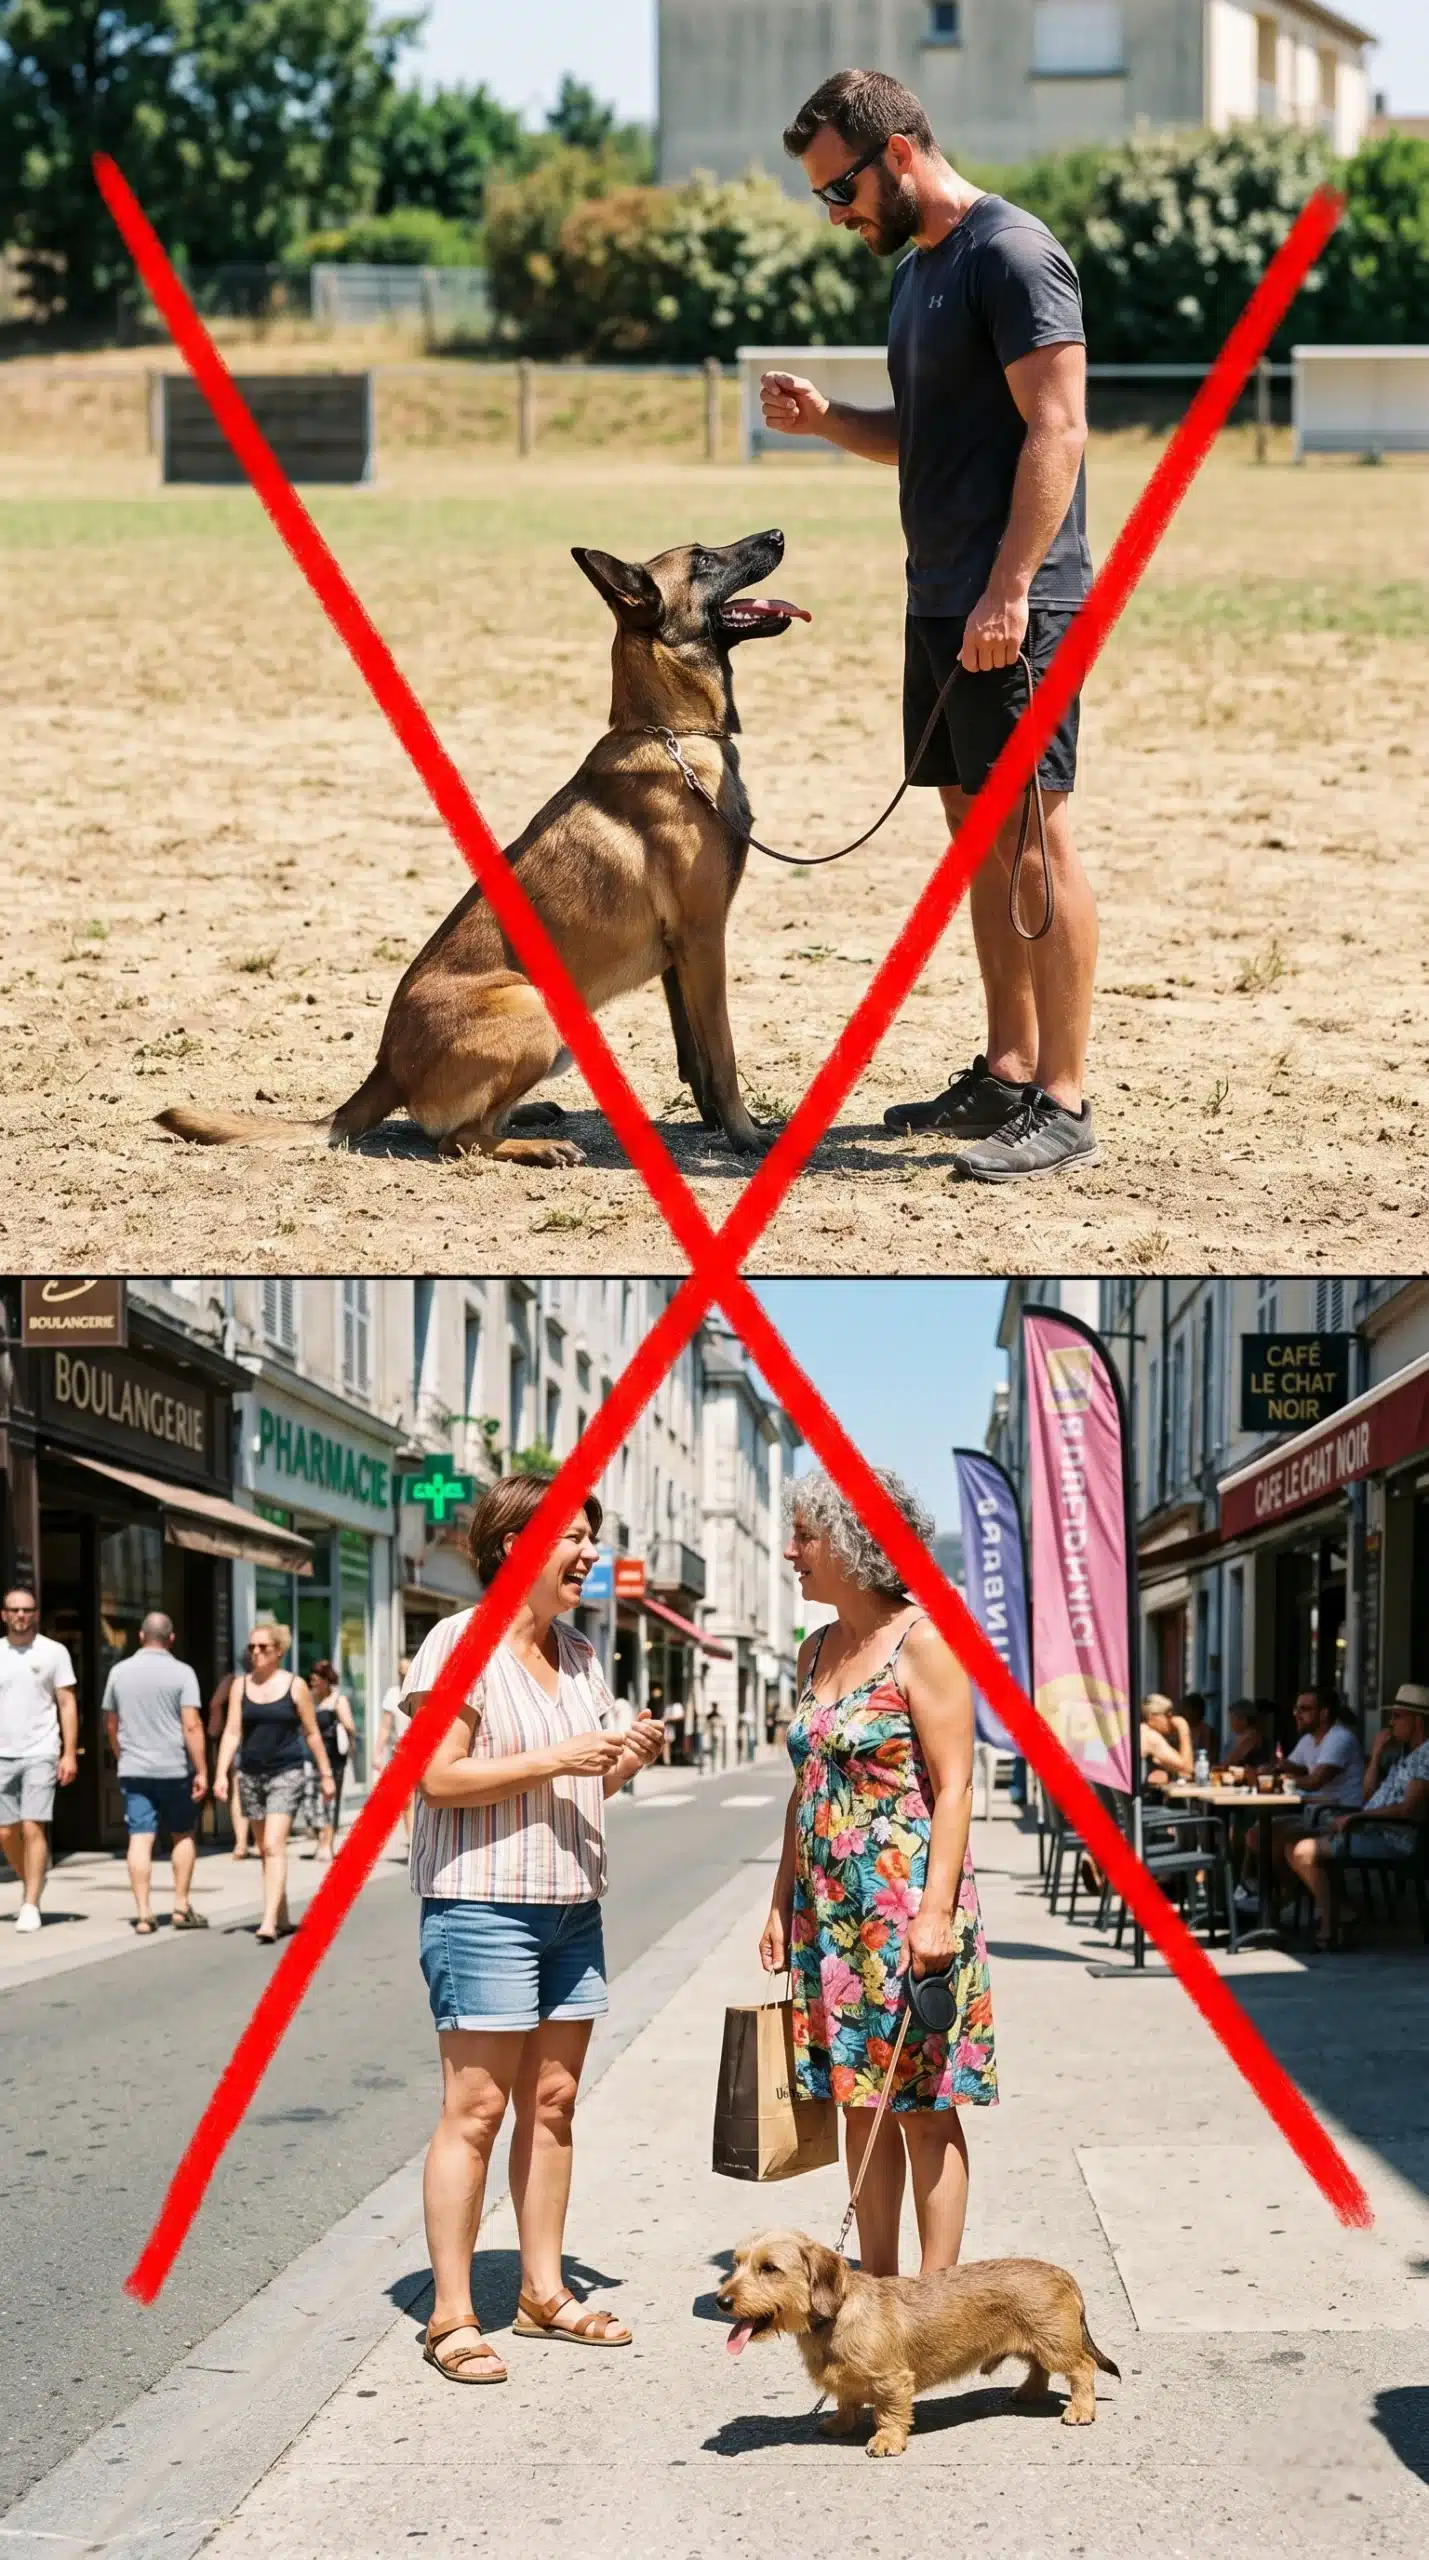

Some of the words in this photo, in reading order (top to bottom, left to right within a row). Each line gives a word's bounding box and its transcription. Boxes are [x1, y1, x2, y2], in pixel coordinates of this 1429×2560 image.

[29, 1315, 115, 1330] BOULANGERIE
[1266, 1341, 1321, 1367] CAFÉ
[1251, 1372, 1275, 1394] LE
[1281, 1372, 1337, 1394] CHAT
[55, 1351, 204, 1452] BOULANGERIE
[1267, 1399, 1320, 1420] NOIR
[258, 1406, 388, 1509] PHARMACIE
[1284, 1460, 1300, 1504] LE
[1301, 1441, 1335, 1497] CHAT
[1336, 1421, 1370, 1479] NOIR
